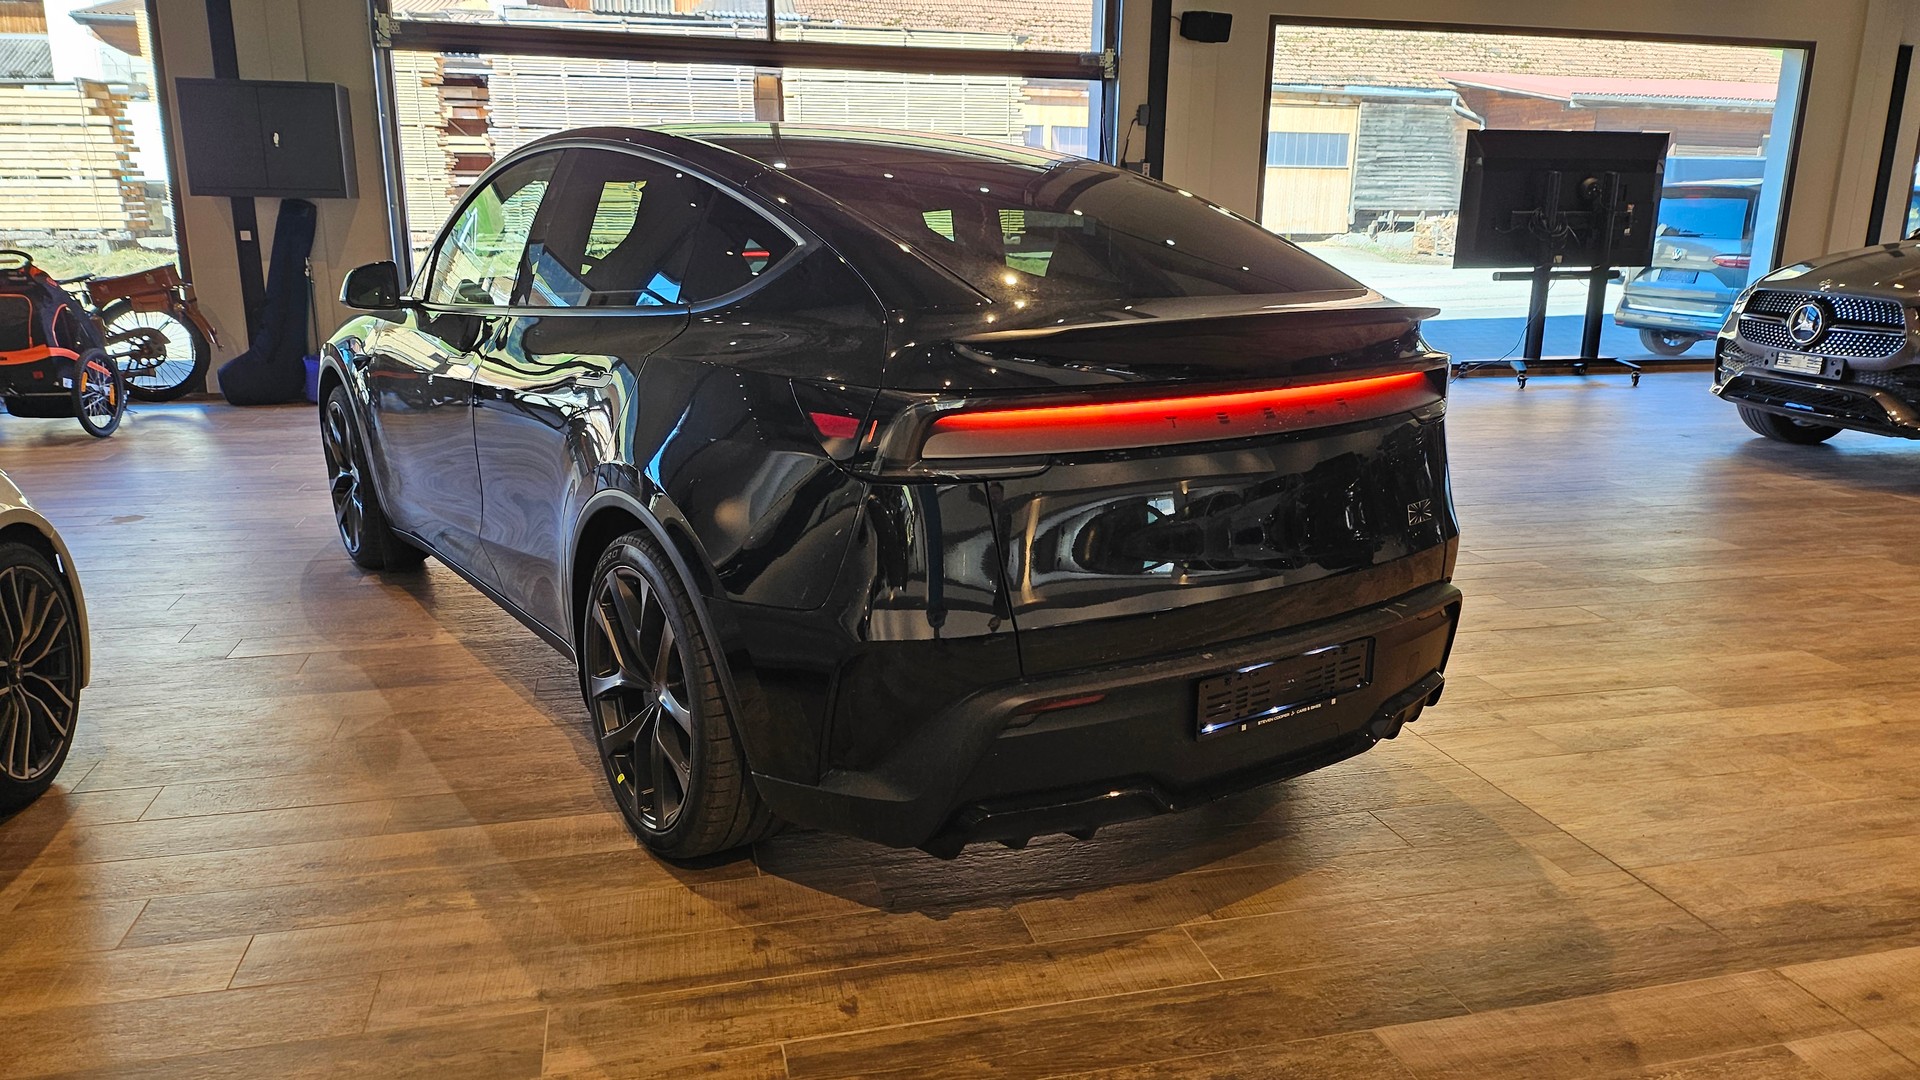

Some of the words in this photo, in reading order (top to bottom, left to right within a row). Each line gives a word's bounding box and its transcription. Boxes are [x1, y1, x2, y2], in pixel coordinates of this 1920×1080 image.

[1165, 398, 1347, 428] TESLA
[1257, 717, 1274, 725] STEVEN
[1274, 712, 1290, 721] COOPER
